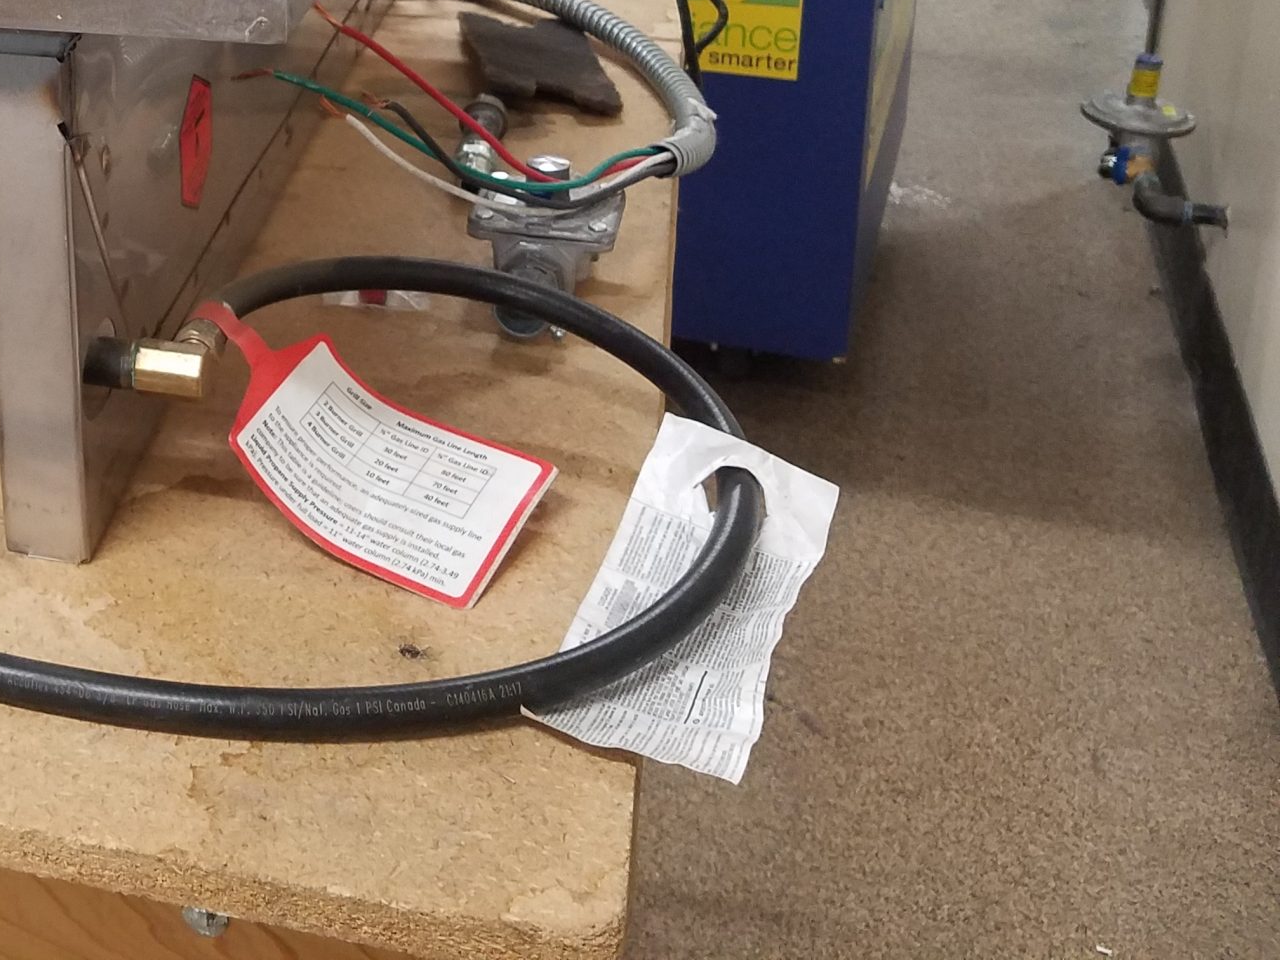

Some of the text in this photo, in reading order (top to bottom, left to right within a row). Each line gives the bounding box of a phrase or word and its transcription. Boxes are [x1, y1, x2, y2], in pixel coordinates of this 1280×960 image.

[708, 51, 797, 71] smarter
[346, 387, 360, 400] Grill
[328, 405, 348, 426] Burner
[348, 424, 363, 437] Grill
[311, 425, 331, 447] Burner
[331, 446, 346, 460] Grill
[320, 416, 339, 436] Burner
[340, 435, 355, 449] Grill
[395, 420, 488, 461] Maximum Gas Line Length
[390, 434, 404, 443] Gas
[404, 439, 419, 450] Line
[420, 446, 429, 454] ID
[374, 458, 399, 473] 20 feet
[393, 450, 408, 461] feet
[448, 456, 461, 466] Gas
[462, 462, 478, 473] Line
[365, 470, 390, 486] 10 feet
[452, 472, 467, 483] feet
[262, 419, 278, 439] Note:
[363, 511, 388, 526] should
[387, 522, 415, 536] consult
[415, 532, 433, 545] their
[434, 540, 453, 553] local
[451, 549, 465, 558] gas
[432, 481, 458, 495] 70 feet
[250, 434, 268, 456] Liquid
[265, 454, 289, 482] Propane
[288, 481, 309, 503] Supply
[309, 501, 338, 525] Pressure
[370, 539, 391, 550] water
[391, 547, 420, 563] column
[279, 455, 286, 465] to
[285, 463, 293, 473] be
[294, 472, 307, 486] sure
[306, 485, 320, 499] that
[320, 498, 329, 506] an
[329, 504, 362, 526] adequate
[361, 524, 374, 533] gas
[376, 529, 399, 543] supply
[423, 493, 449, 509] 40 feet
[360, 488, 370, 496] an
[370, 494, 408, 512] adequately
[410, 508, 429, 519] sized
[427, 516, 441, 525] gas
[442, 521, 466, 536] supply
[468, 530, 483, 541] line
[278, 484, 296, 504] under
[296, 502, 308, 515] full
[306, 512, 324, 526] load
[342, 537, 364, 550] water
[363, 546, 391, 562] column
[391, 557, 412, 572] (2.74
[411, 565, 429, 580] kPa)
[332, 702, 351, 717] Gas
[365, 700, 383, 715] PSI
[386, 697, 426, 713] Canada
